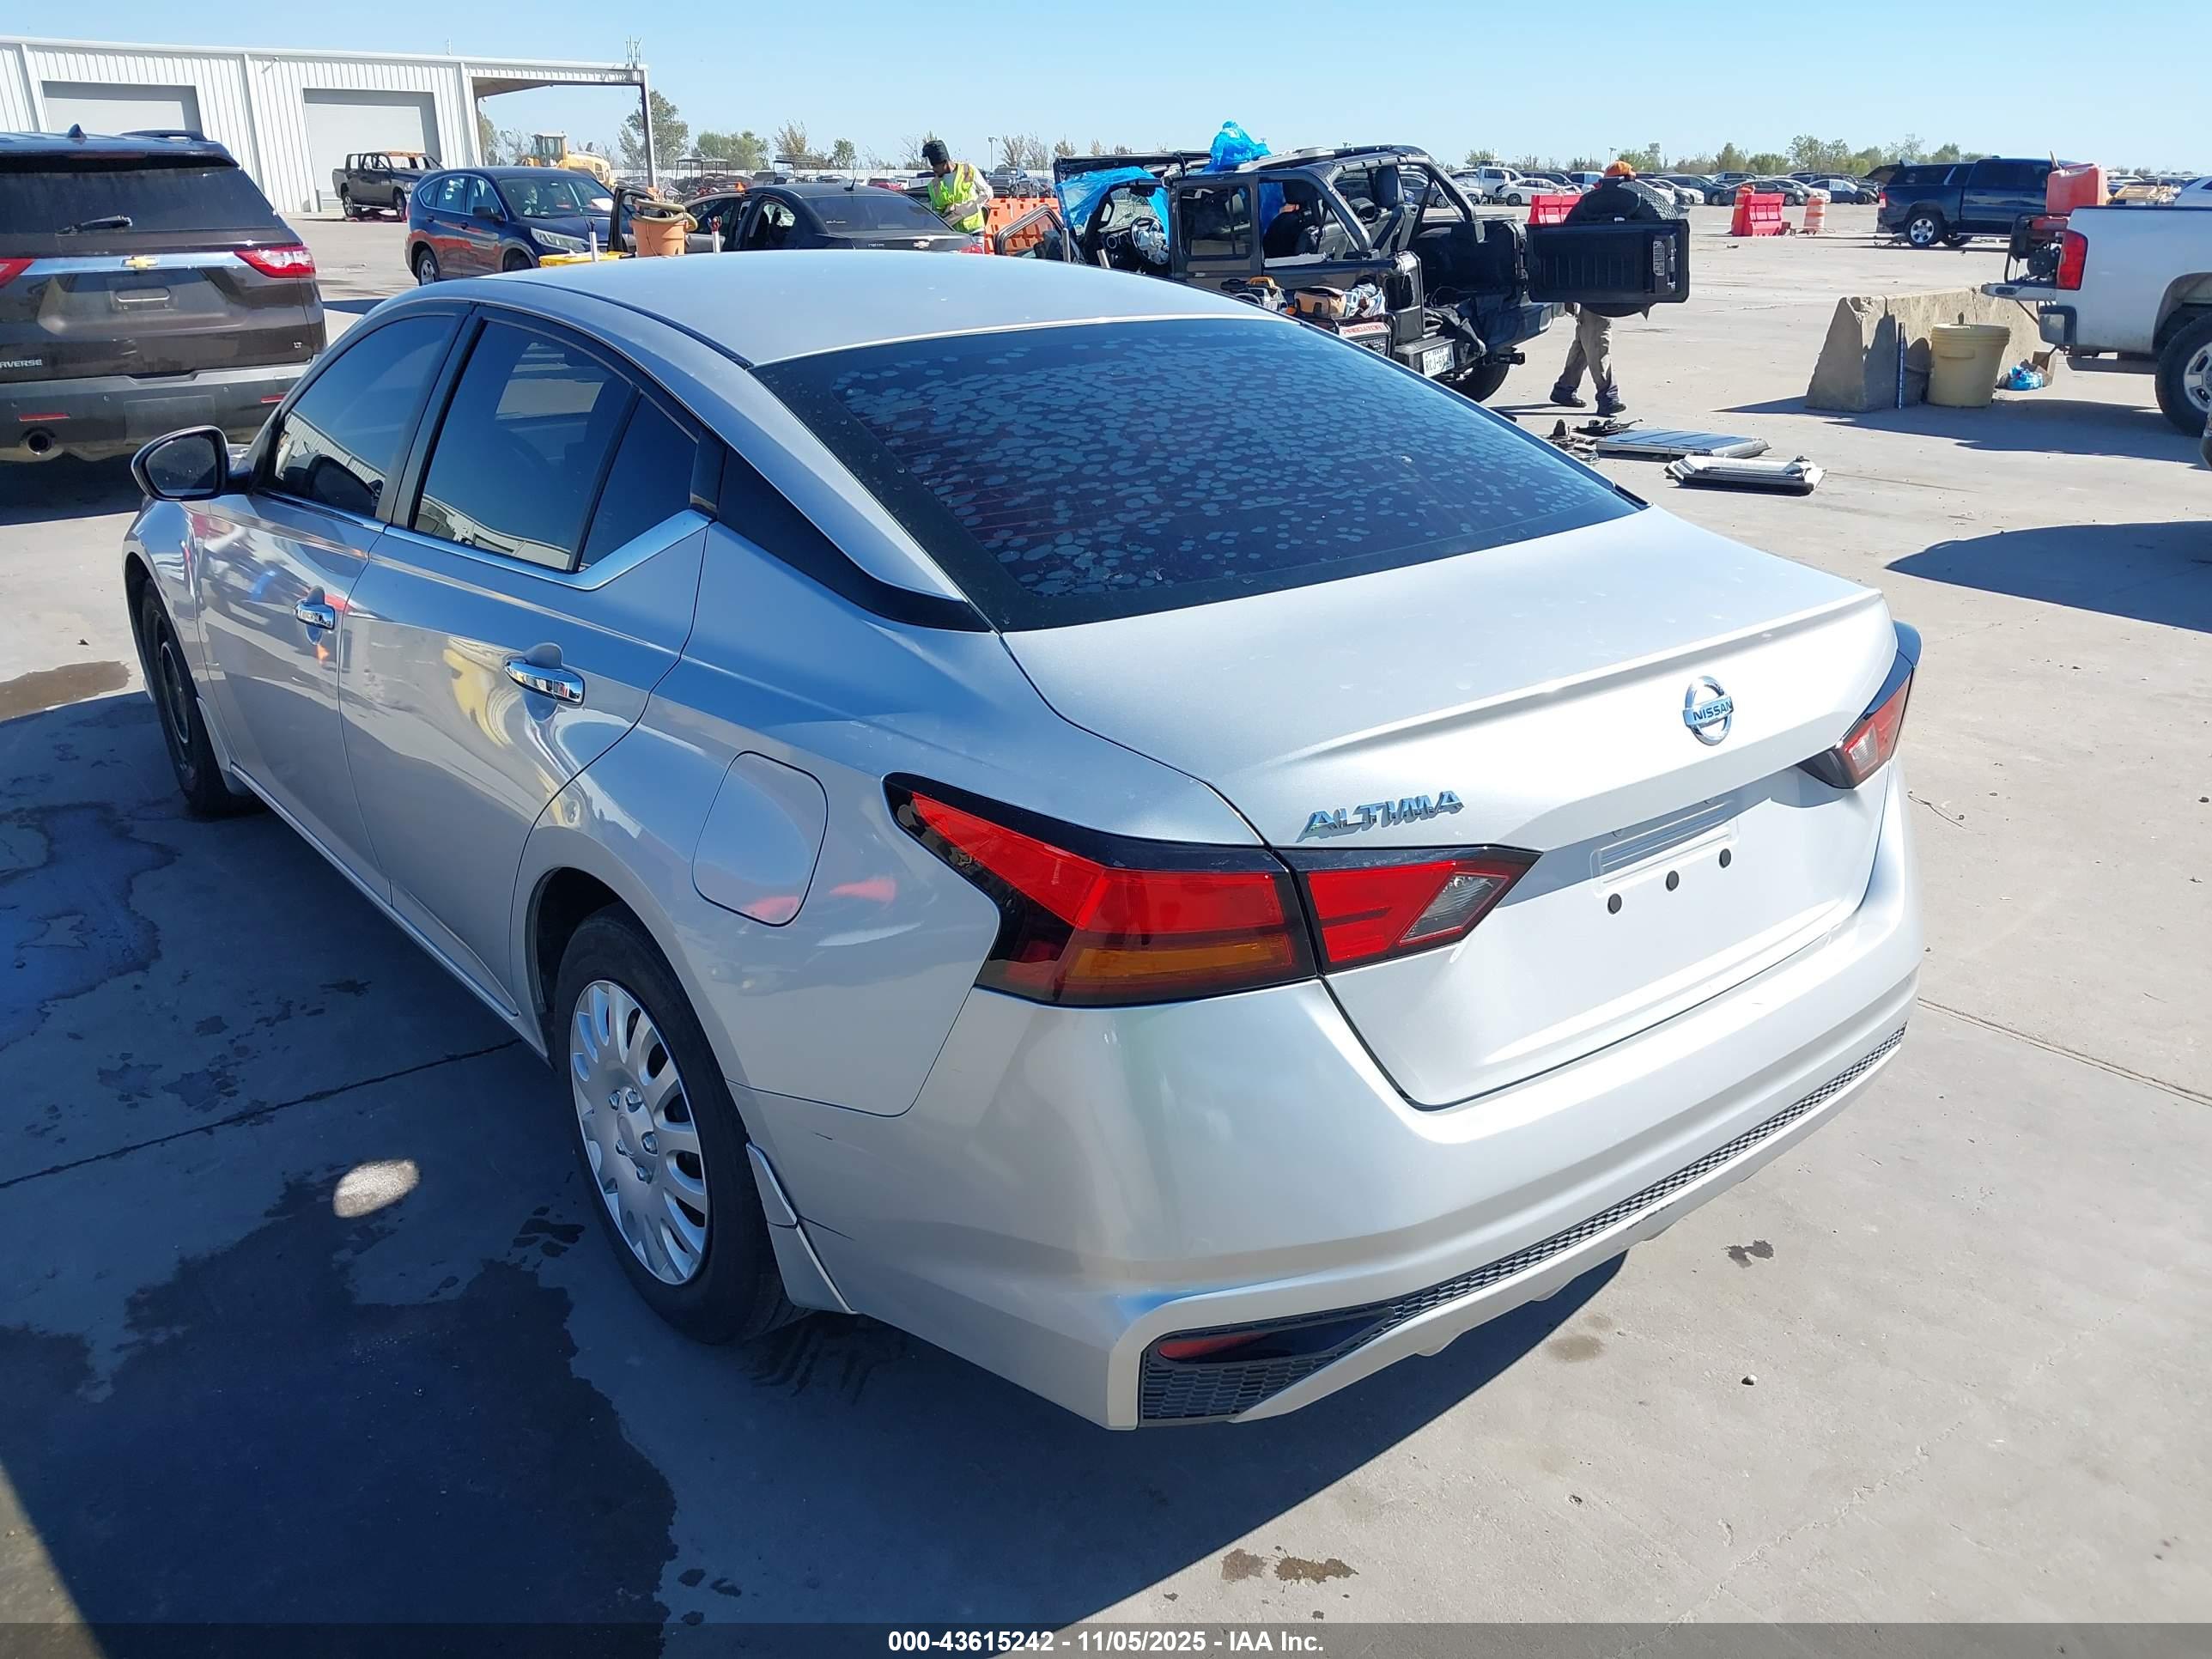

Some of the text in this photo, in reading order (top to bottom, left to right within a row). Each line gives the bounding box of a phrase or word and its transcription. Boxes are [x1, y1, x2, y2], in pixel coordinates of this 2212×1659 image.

[0, 359, 42, 368] AVERSE
[1692, 700, 1732, 721] NISSAN
[1304, 790, 1463, 835] ALTIMA
